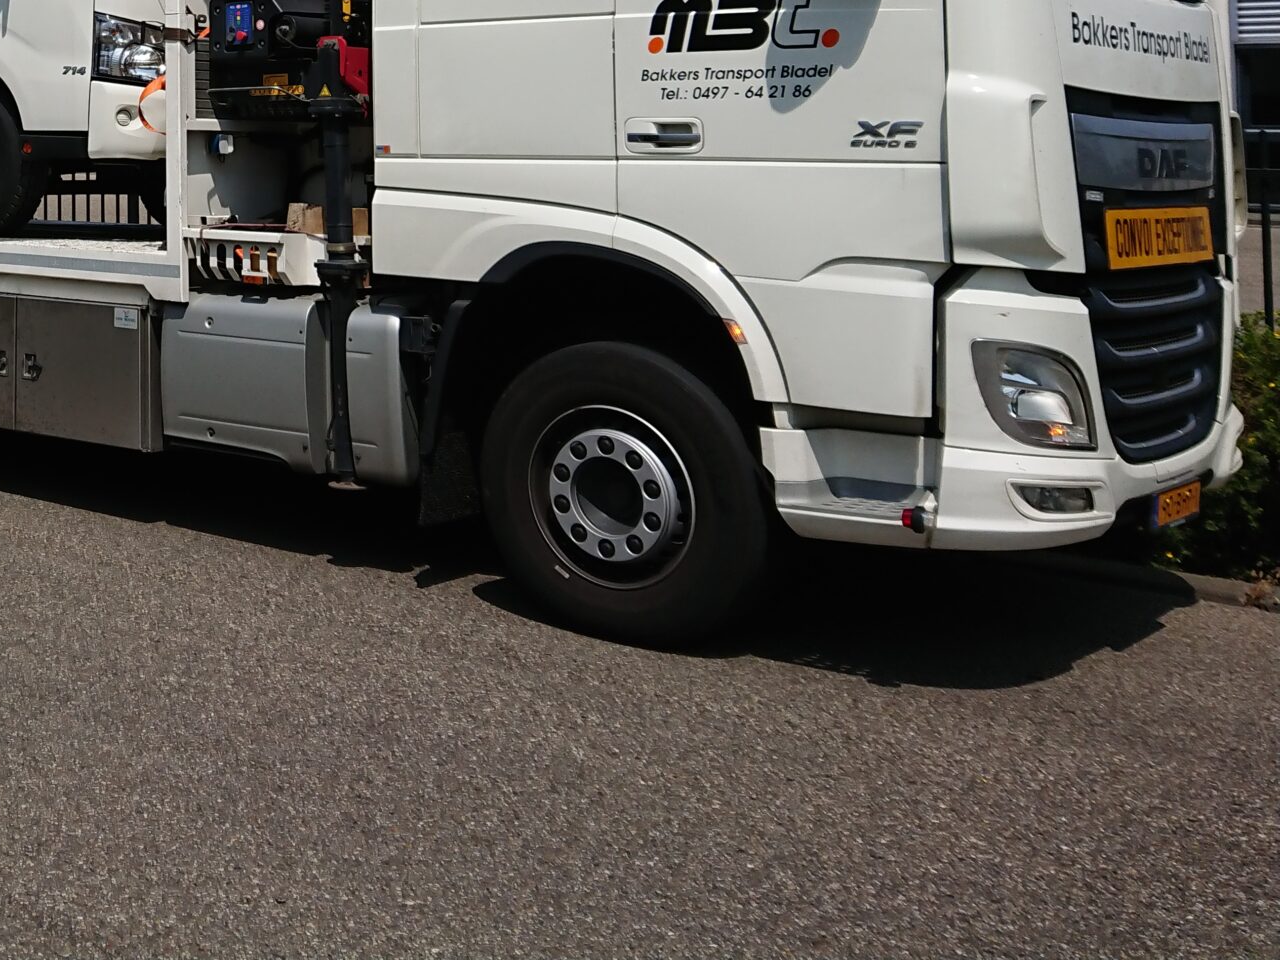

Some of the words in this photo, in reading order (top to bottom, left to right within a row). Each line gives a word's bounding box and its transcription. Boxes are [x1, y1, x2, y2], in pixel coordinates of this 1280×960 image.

[1071, 11, 1131, 52] Bakkers
[1129, 21, 1183, 64] Transport
[1182, 31, 1211, 64] Bladel
[61, 65, 87, 76] 714
[640, 68, 700, 82] Bakkers
[703, 65, 777, 82] Transport
[780, 63, 834, 79] Bladel
[660, 87, 688, 100] Tel.:
[692, 85, 729, 100] 0497
[744, 85, 764, 99] 64
[768, 84, 786, 99] 21
[792, 84, 812, 98] 86
[852, 120, 925, 139] XF
[849, 139, 901, 148] EURO
[1137, 147, 1188, 179] DAF
[1115, 218, 1154, 258] CONVOI
